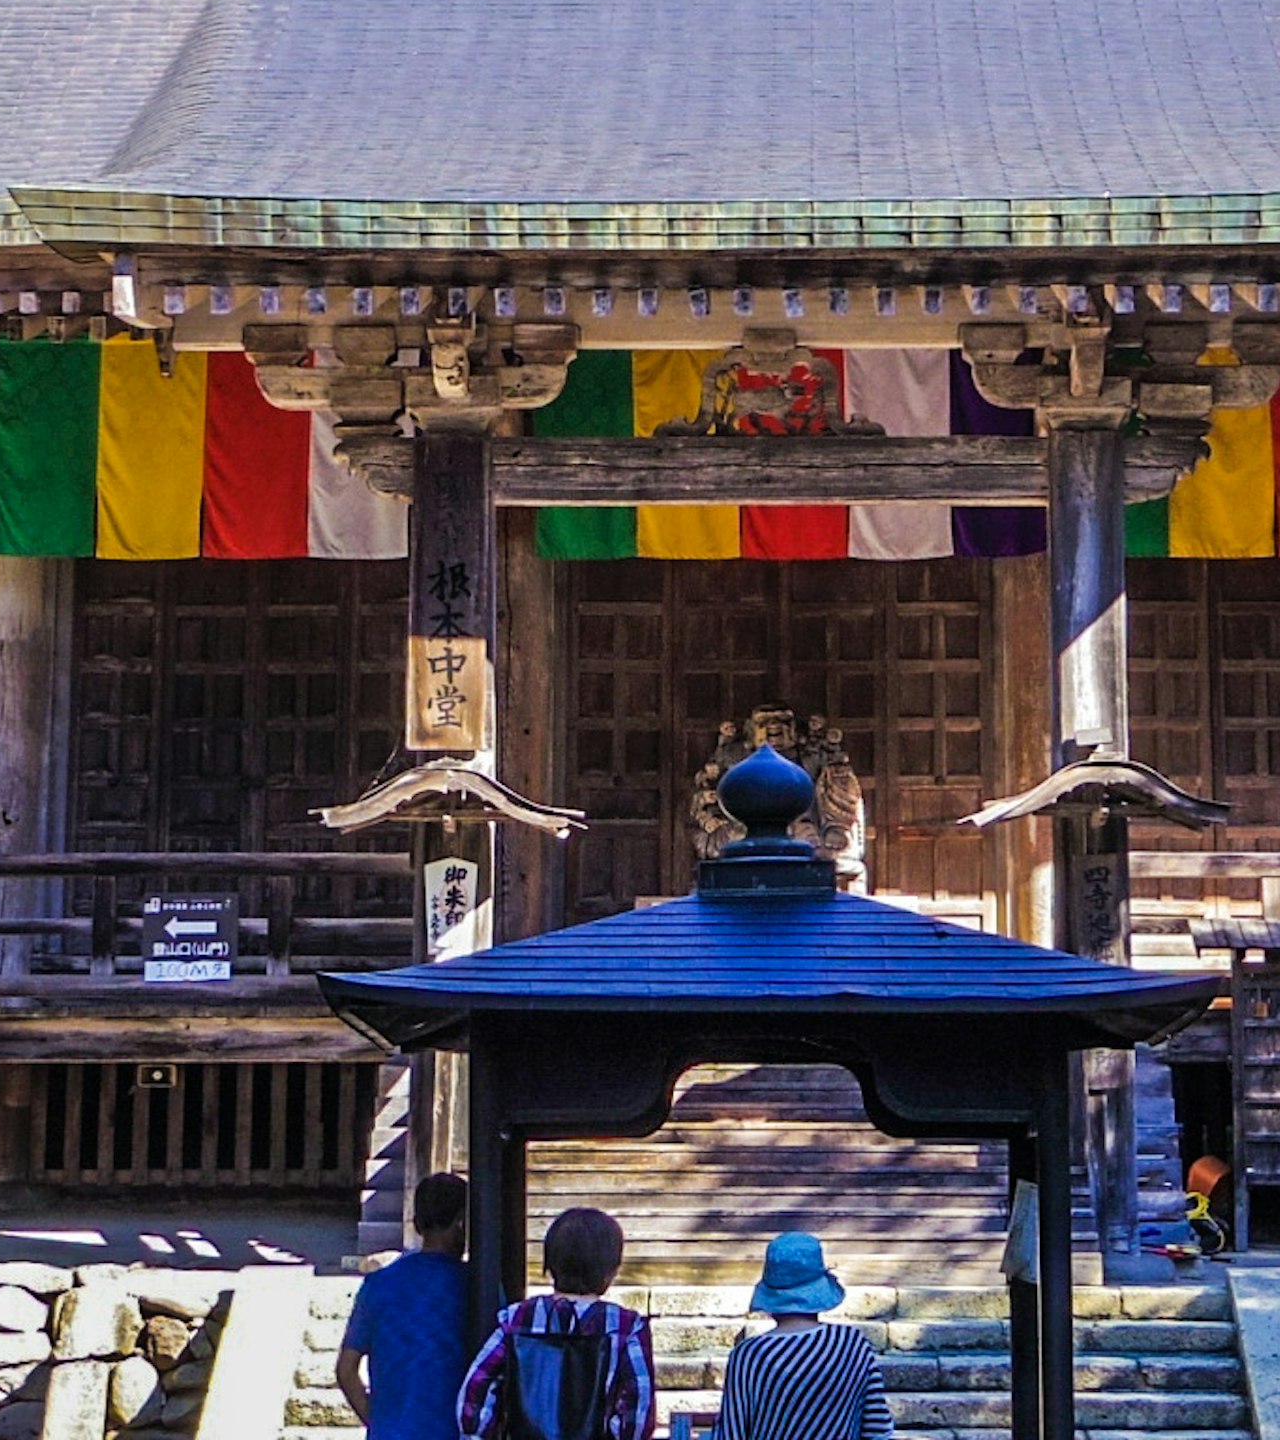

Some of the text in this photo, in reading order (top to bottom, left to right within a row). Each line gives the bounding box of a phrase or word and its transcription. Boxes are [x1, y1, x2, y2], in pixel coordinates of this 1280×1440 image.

[426, 560, 472, 729] 根本中堂
[443, 864, 467, 927] 御朱印
